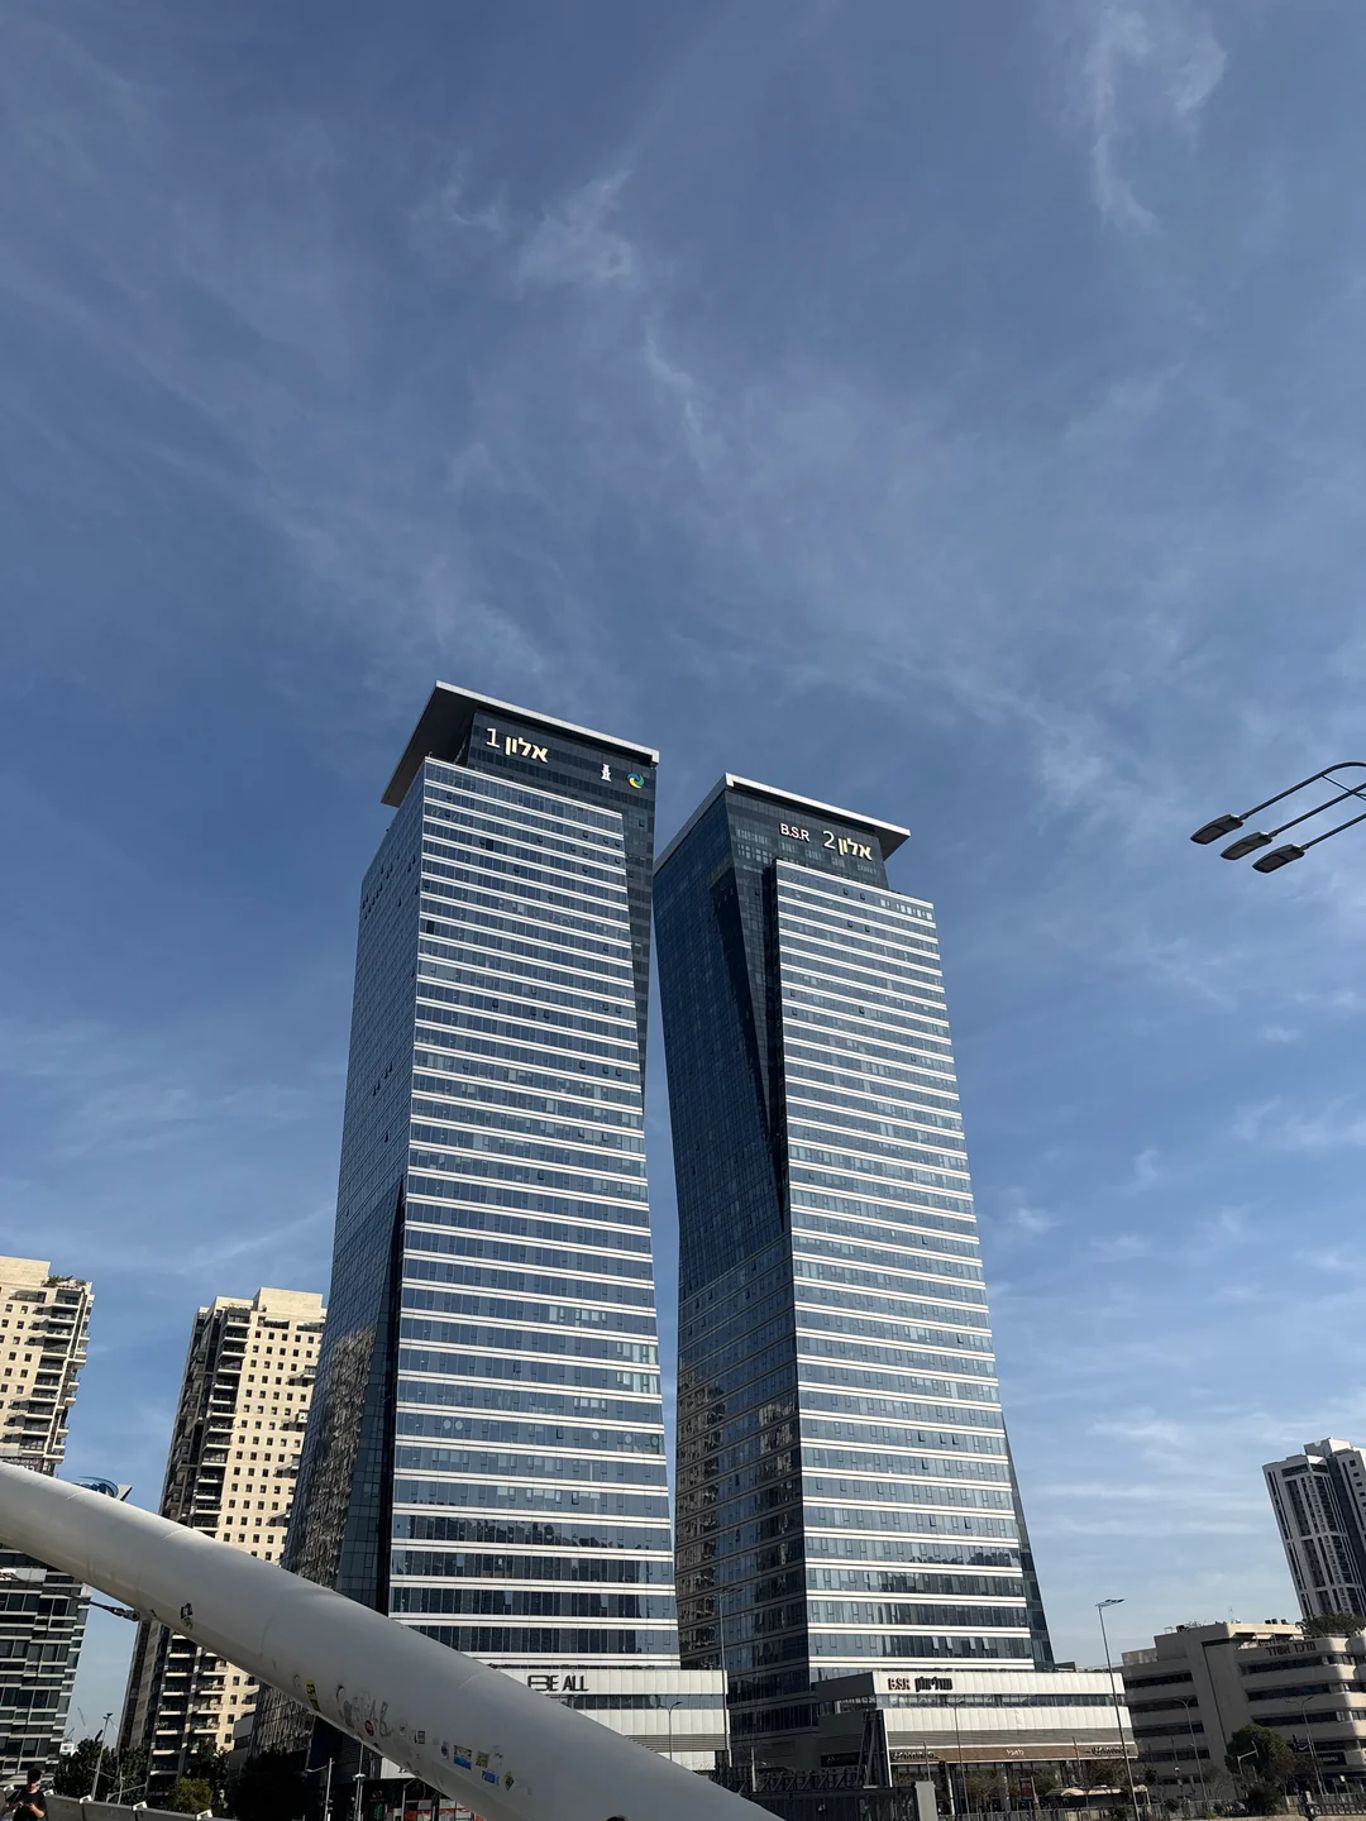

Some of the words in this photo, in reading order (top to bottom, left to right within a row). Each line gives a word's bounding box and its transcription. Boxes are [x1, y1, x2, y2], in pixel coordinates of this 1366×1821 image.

[486, 727, 500, 748] 1
[505, 736, 548, 763] אלון
[780, 822, 810, 842] B.S.R
[822, 830, 836, 850] 2
[837, 837, 873, 861] אלון
[561, 1674, 589, 1692] ALL
[888, 1677, 911, 1690] BSR
